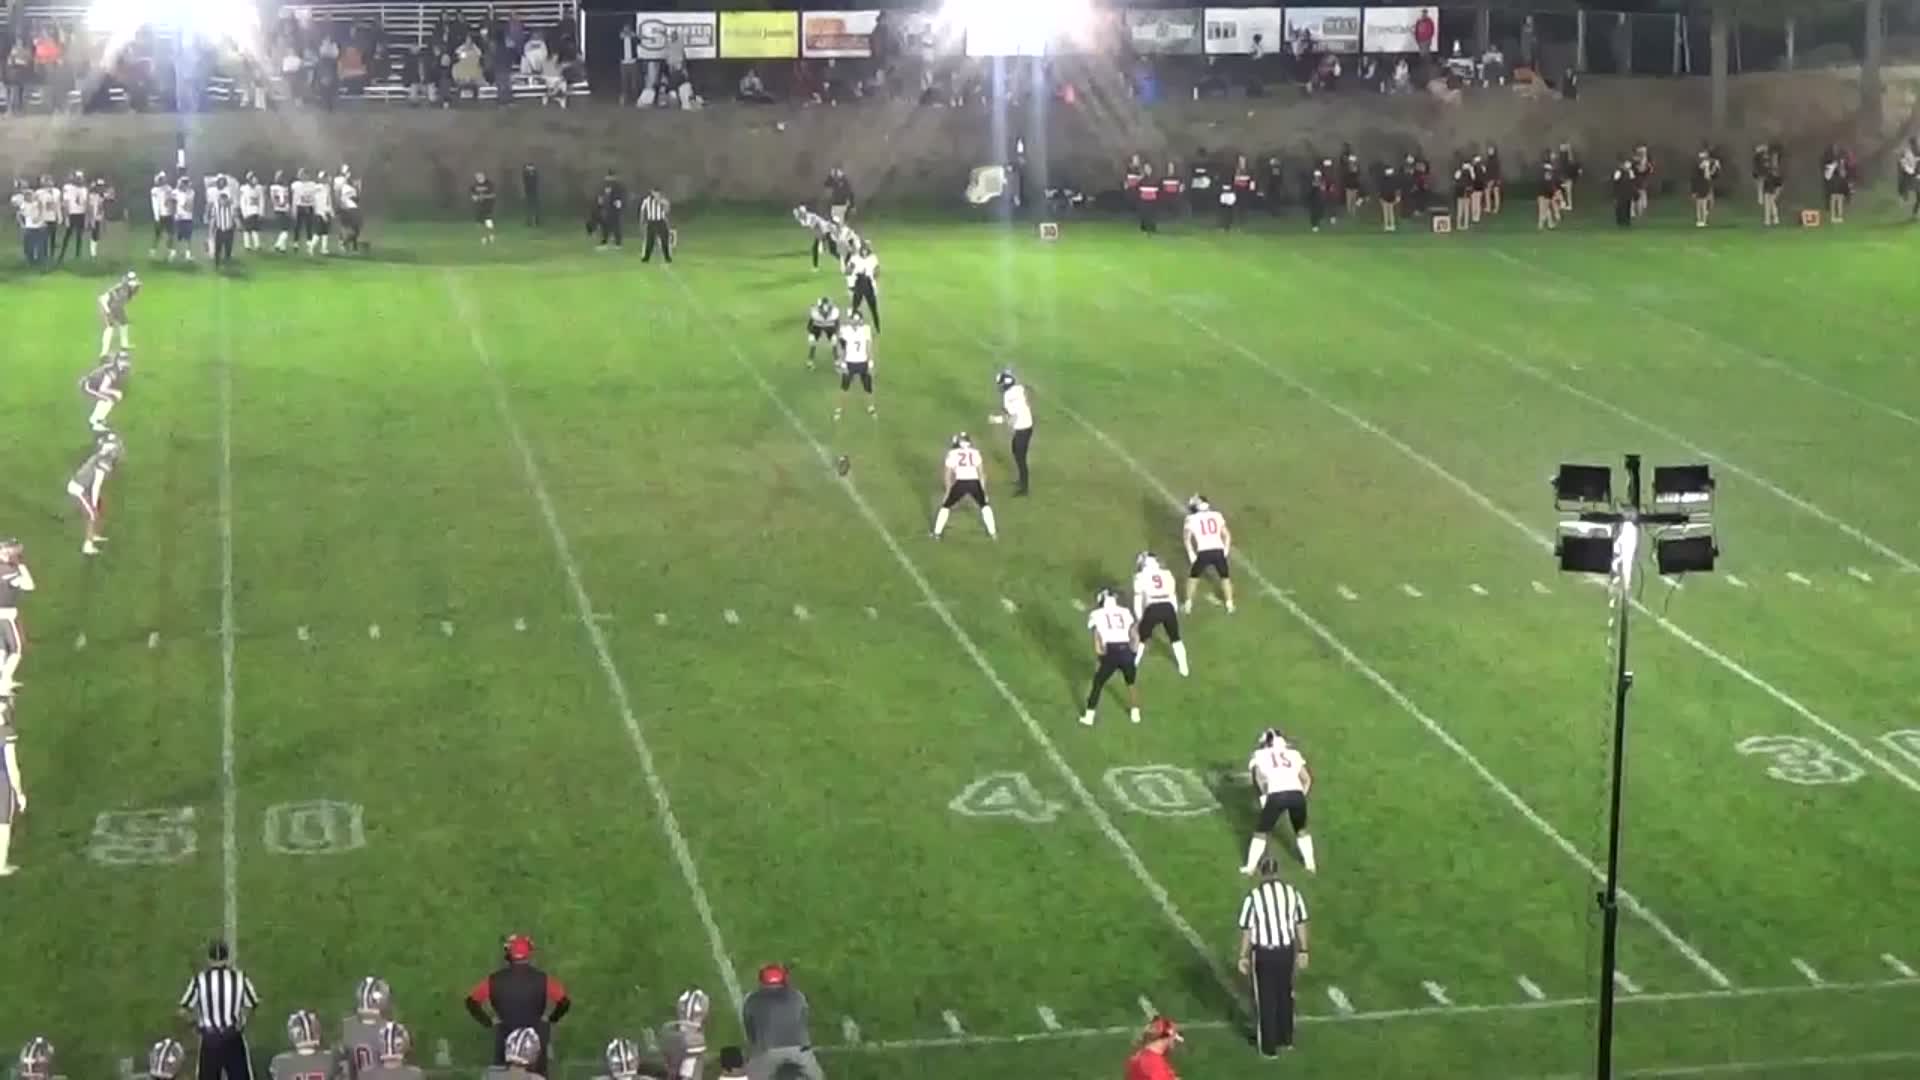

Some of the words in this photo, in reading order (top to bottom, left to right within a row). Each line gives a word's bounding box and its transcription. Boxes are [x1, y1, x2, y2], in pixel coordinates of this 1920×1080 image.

[854, 341, 861, 353] 7
[957, 452, 976, 467] 21
[1200, 518, 1218, 536] 10
[1152, 575, 1164, 590] 9
[1106, 613, 1126, 630] 13
[1271, 752, 1292, 769] 15
